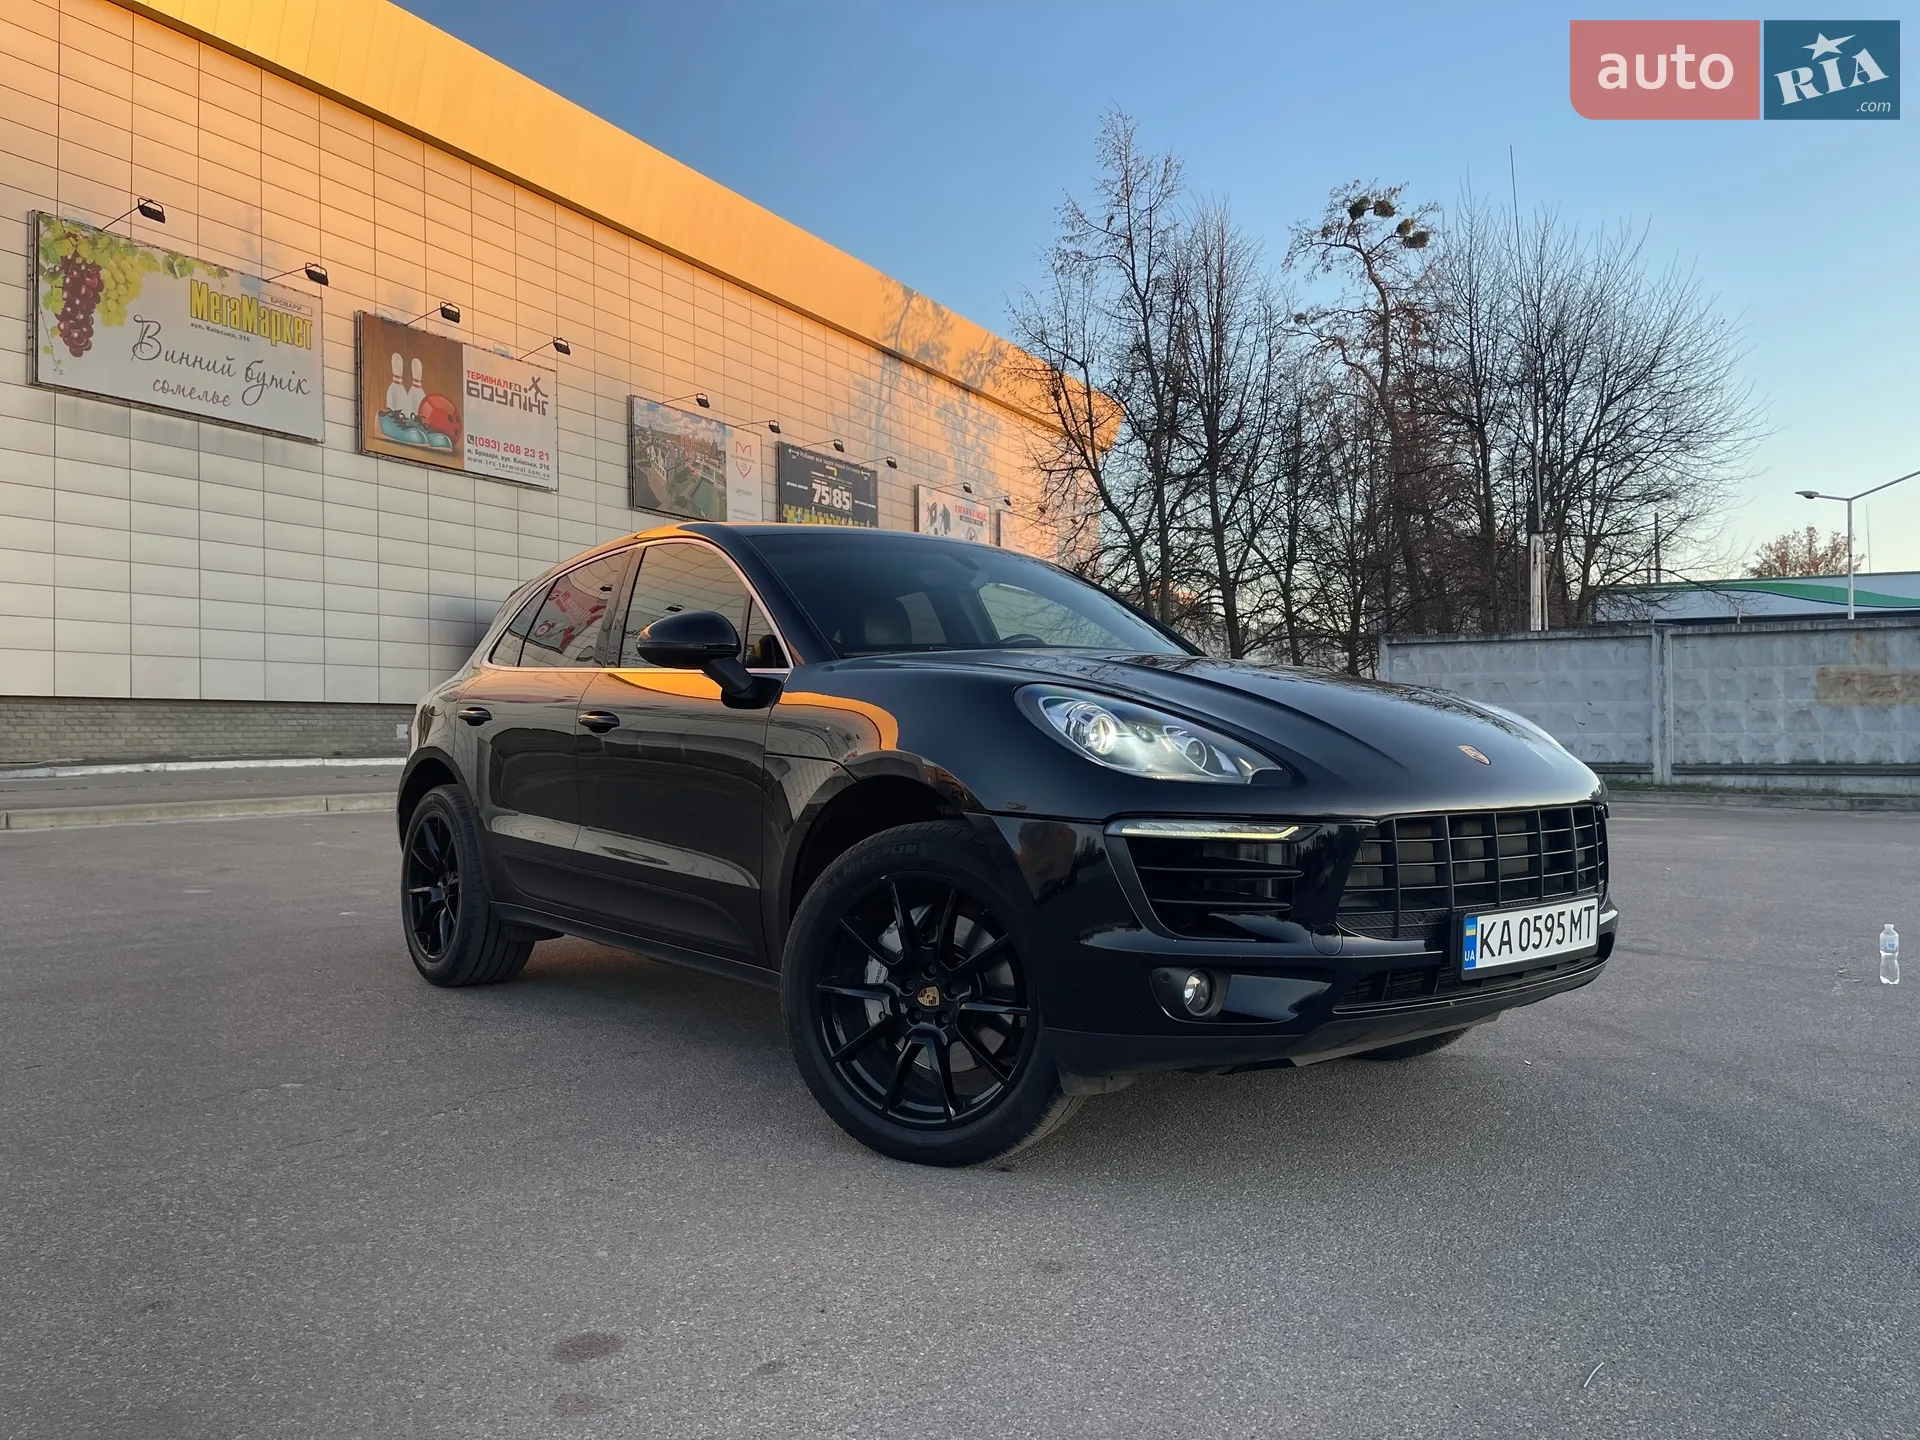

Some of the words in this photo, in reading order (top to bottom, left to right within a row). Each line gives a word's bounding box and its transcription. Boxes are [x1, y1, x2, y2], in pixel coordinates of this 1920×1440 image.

[190, 278, 313, 351] МегаМаркет
[270, 297, 302, 311] БРОВАРИ
[190, 322, 205, 330] вул.
[130, 314, 236, 377] Винний
[241, 359, 311, 406] бутік
[152, 377, 232, 408] сомельє
[466, 369, 508, 388] ТЕРМІНАЛ
[466, 379, 549, 416] БОУЛІНГ
[474, 435, 500, 452] (093)
[503, 442, 521, 455] 208
[524, 447, 536, 458] 23
[538, 451, 549, 462] 21
[812, 482, 830, 506] 75
[832, 488, 850, 511] 85
[1479, 919, 1513, 959] KA
[1518, 911, 1566, 952] 0595
[1569, 905, 1596, 943] MT
[1464, 950, 1475, 962] UA
